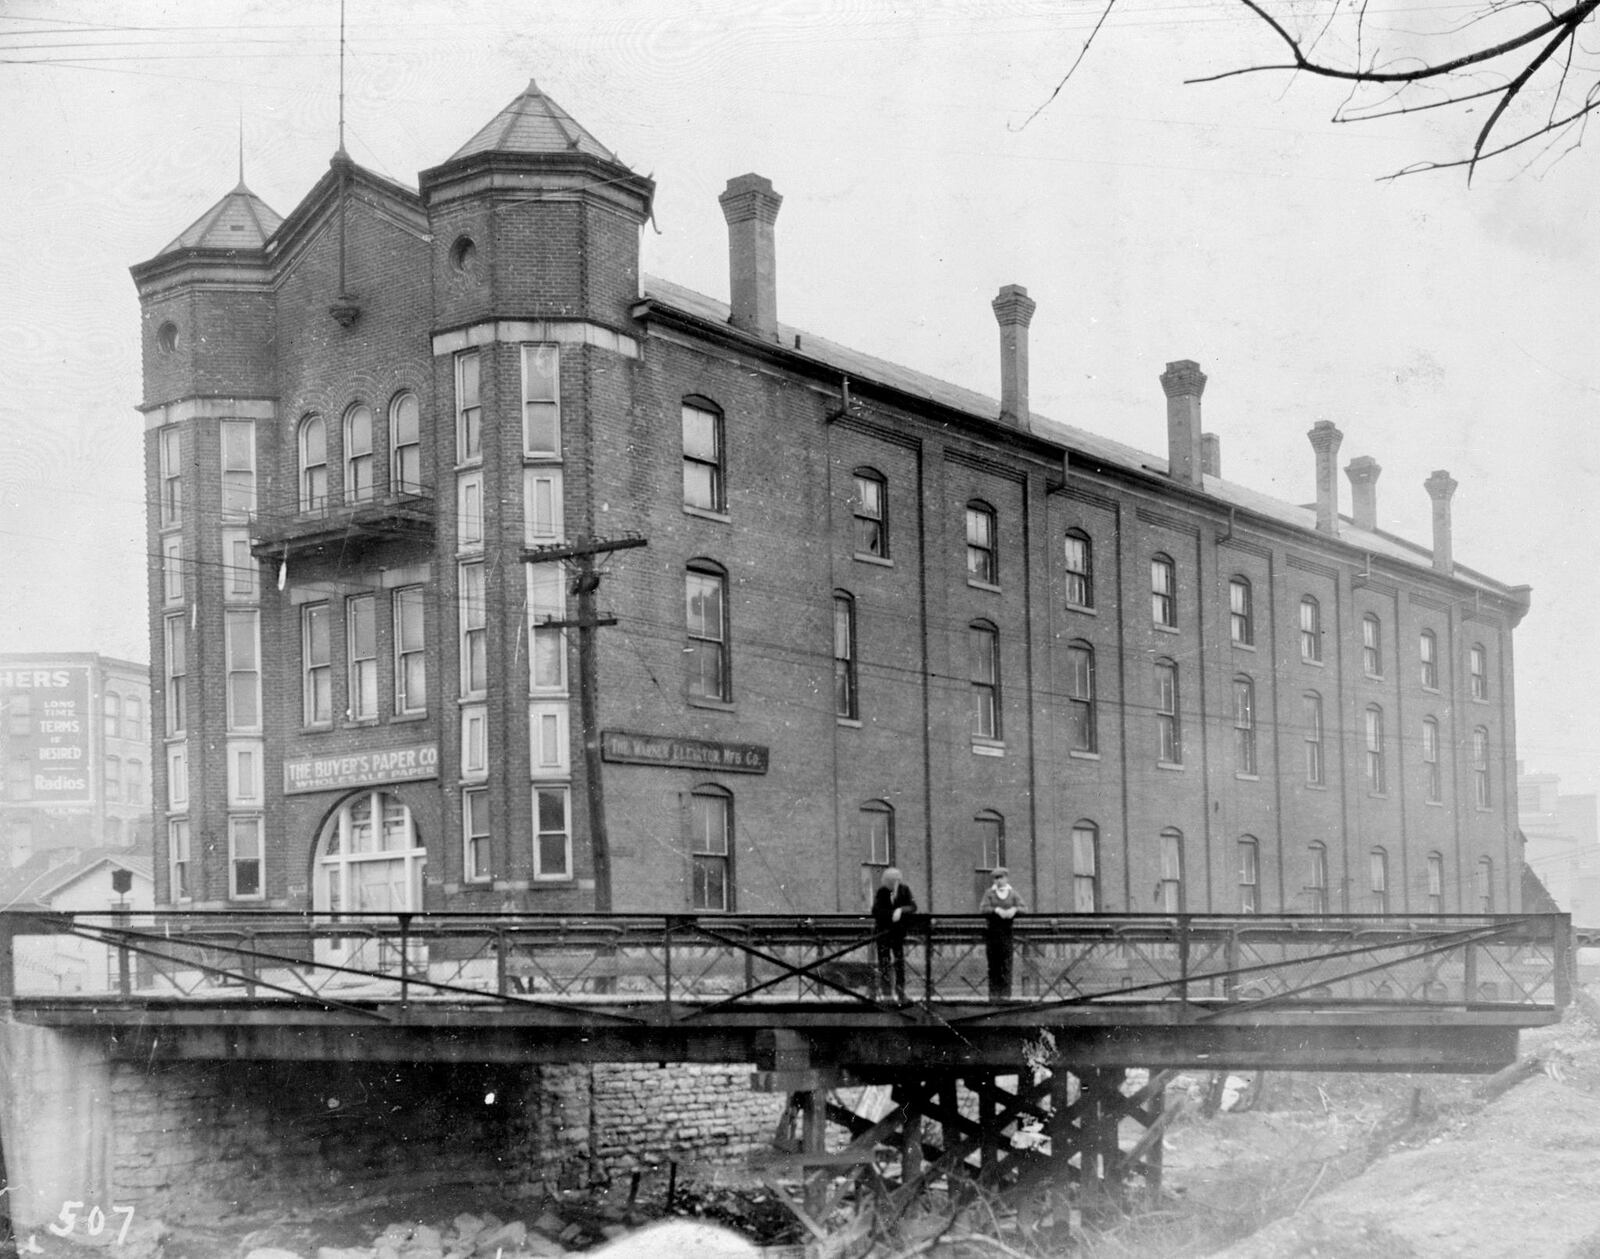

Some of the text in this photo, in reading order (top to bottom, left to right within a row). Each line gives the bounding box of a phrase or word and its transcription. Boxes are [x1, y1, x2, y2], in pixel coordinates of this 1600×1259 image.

[0, 671, 70, 687] HERS
[40, 720, 79, 732] TERMS
[39, 747, 82, 760] DESIRED
[289, 748, 437, 780] THE BUYER'S PAPER CO
[35, 774, 85, 790] Radios
[295, 766, 434, 788] WHOLESALE PAPER
